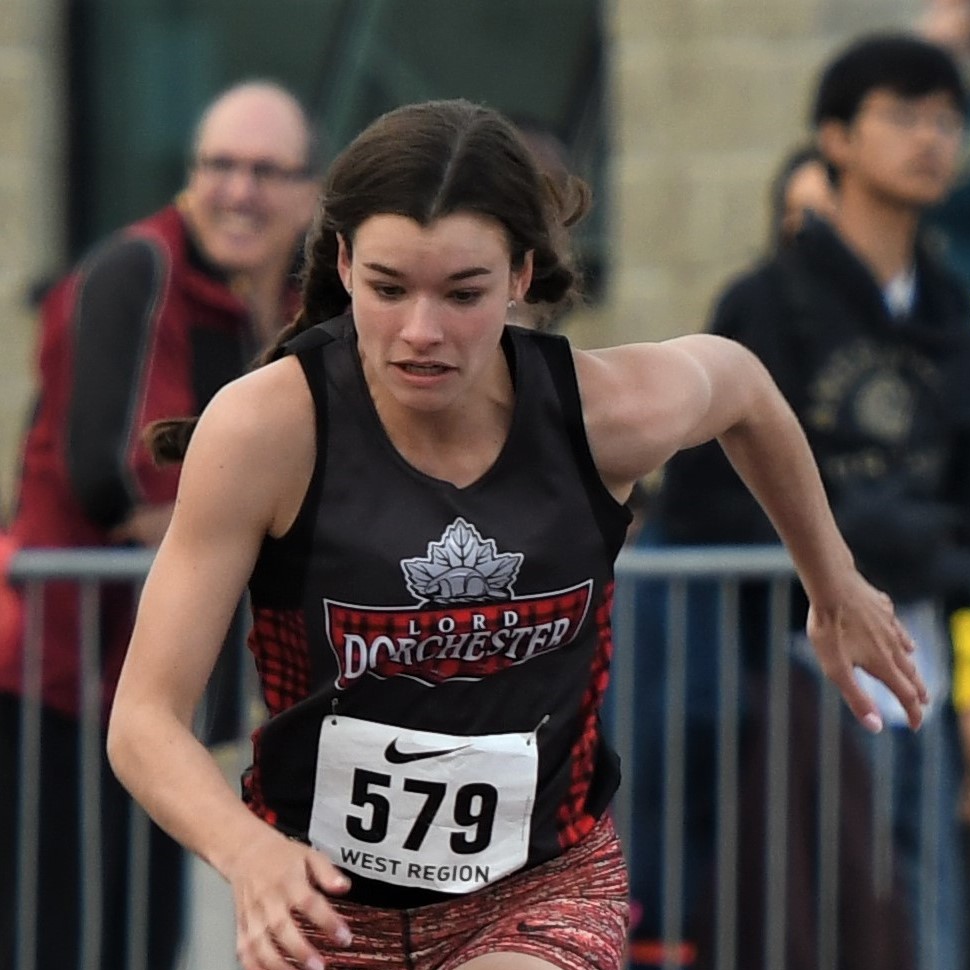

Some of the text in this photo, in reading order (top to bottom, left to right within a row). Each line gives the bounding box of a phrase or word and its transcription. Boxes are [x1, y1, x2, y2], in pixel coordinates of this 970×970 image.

[409, 610, 519, 636] LORD
[343, 617, 571, 679] DORCHESTER
[345, 767, 498, 854] 579
[340, 847, 490, 882] WEST REGION
